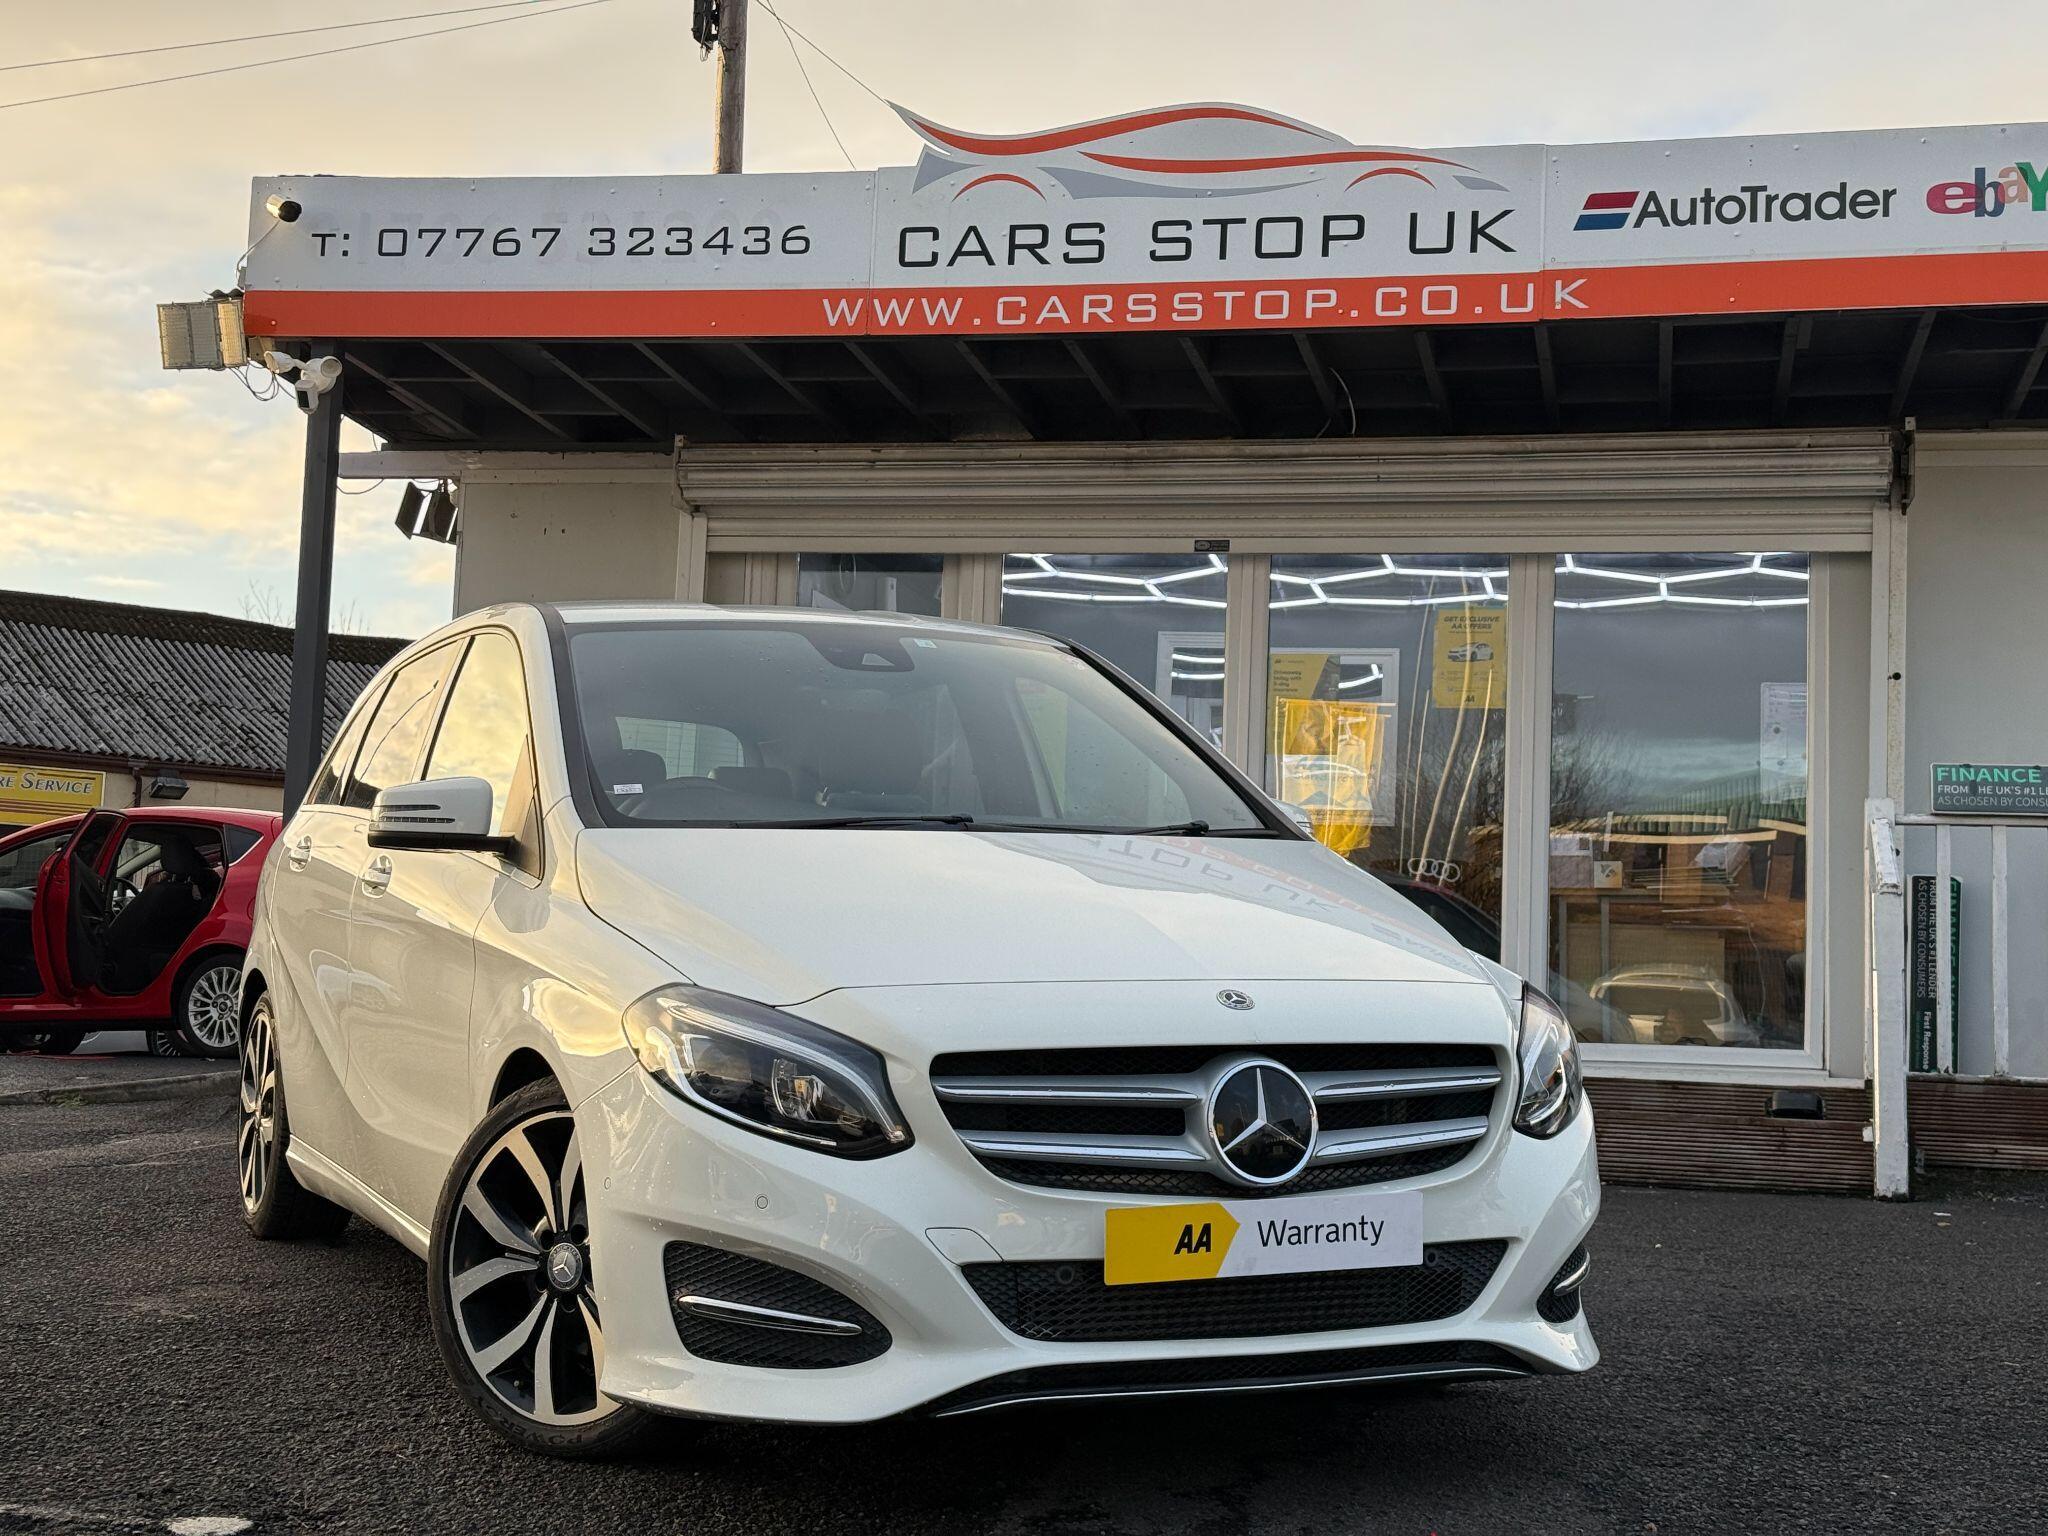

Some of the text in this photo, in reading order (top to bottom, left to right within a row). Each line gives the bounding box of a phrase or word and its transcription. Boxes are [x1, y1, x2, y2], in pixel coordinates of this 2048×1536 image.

[1633, 181, 1897, 229] AutoTrader
[311, 224, 811, 258] T: 07767 323436
[898, 208, 1517, 268] CARS STOP UK
[1936, 767, 2042, 783] FINANCE
[1937, 784, 1969, 794] FROM
[1995, 785, 2021, 795] UK'S
[1937, 796, 1951, 806] AS
[1953, 796, 1998, 806] CHOSEN
[2000, 796, 2014, 806] BY
[1174, 1214, 1385, 1255] AA Warranty
